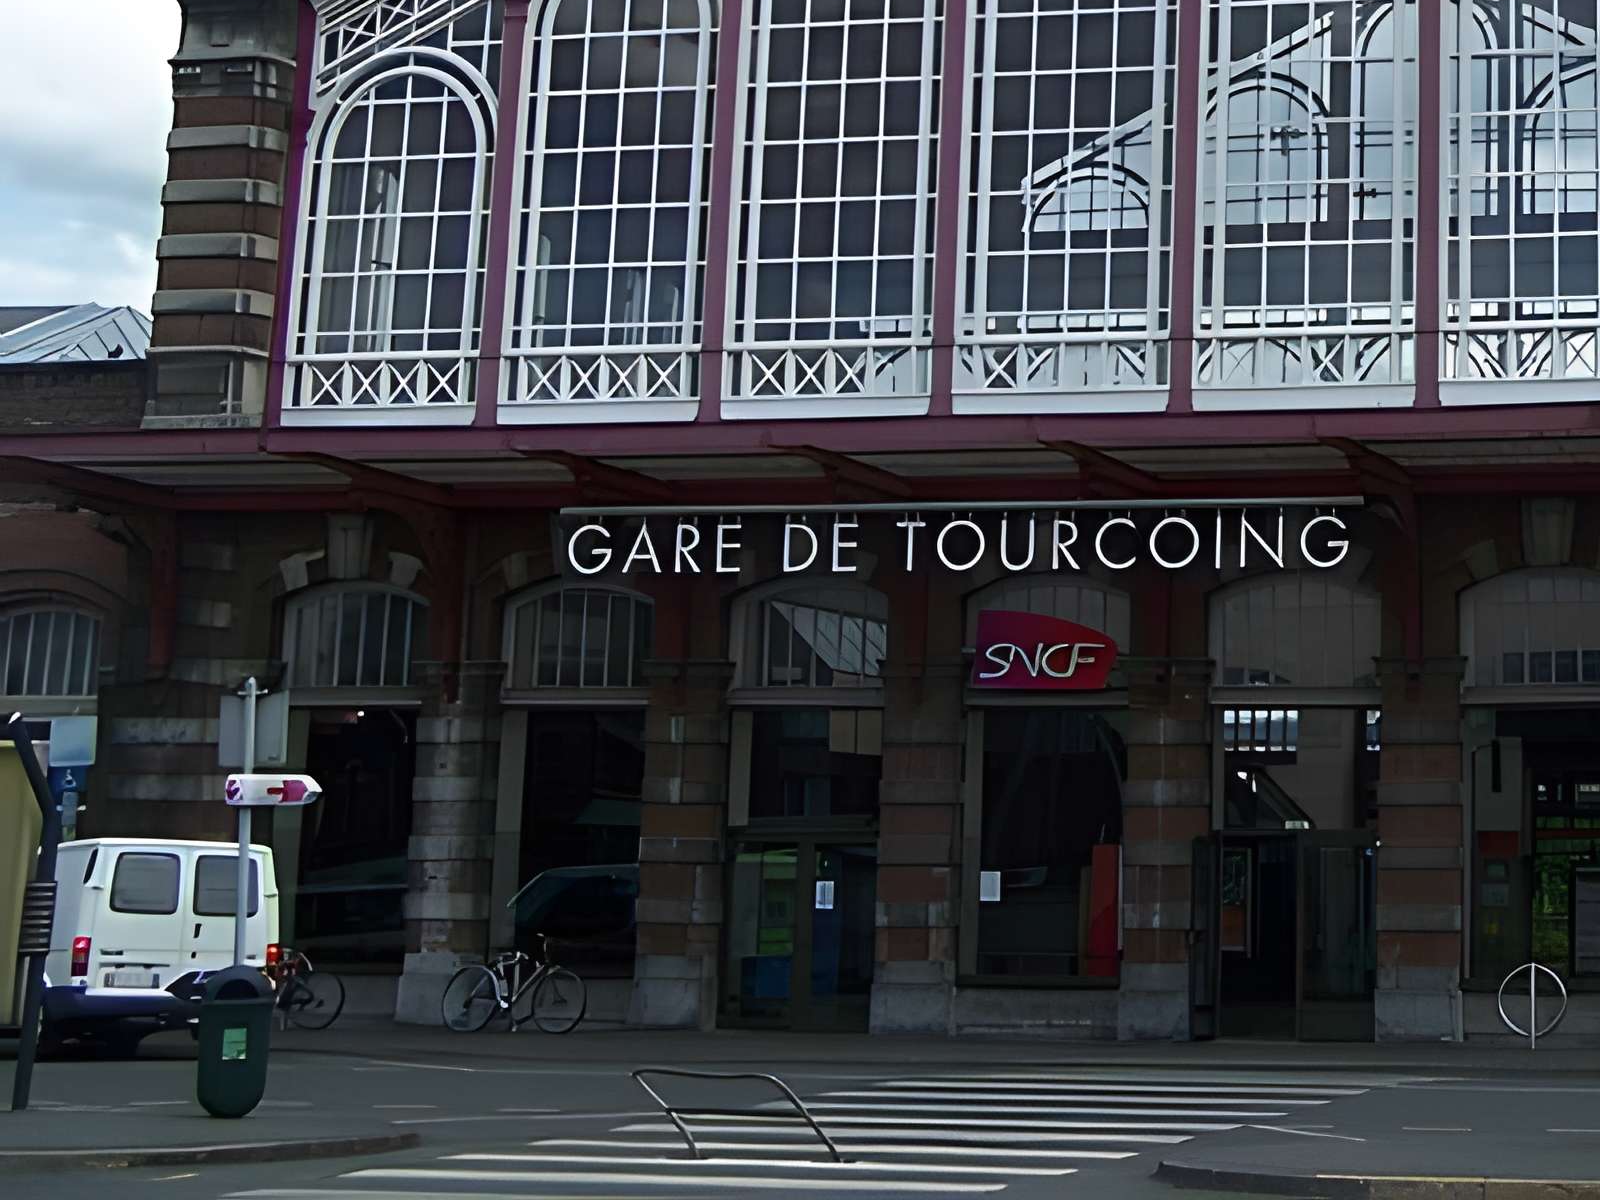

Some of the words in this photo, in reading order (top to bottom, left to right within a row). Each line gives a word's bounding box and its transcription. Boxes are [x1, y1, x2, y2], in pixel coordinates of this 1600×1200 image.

[567, 520, 743, 574] GARE
[783, 522, 860, 573] DE
[896, 514, 1350, 572] TOURCOING
[978, 642, 1106, 679] SNCF
